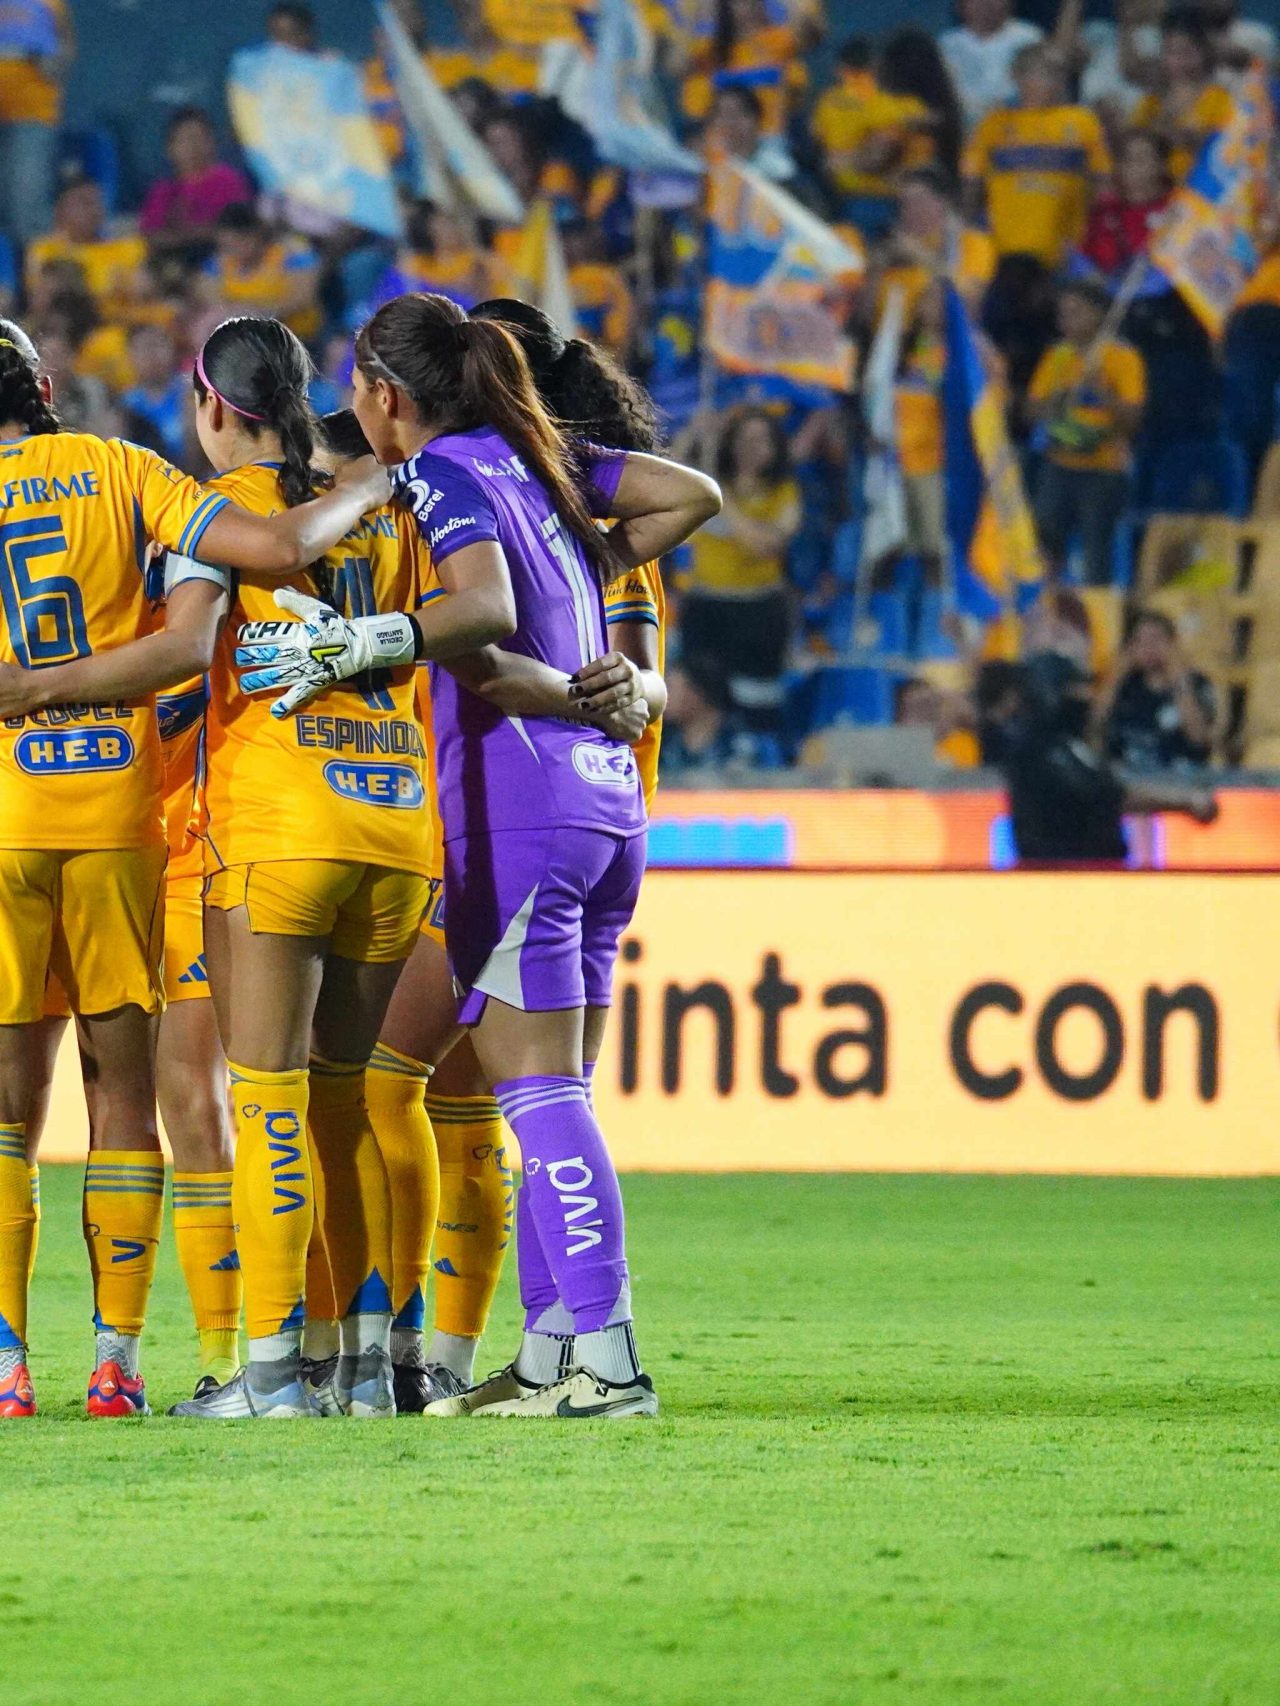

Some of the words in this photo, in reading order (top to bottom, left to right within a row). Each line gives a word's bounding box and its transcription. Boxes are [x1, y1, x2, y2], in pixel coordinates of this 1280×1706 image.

[418, 489, 445, 522] Berel
[430, 516, 476, 547] Hortons
[376, 628, 404, 638] SANTIAGO
[379, 636, 404, 645] CECILIA
[949, 978, 1220, 1104] con
